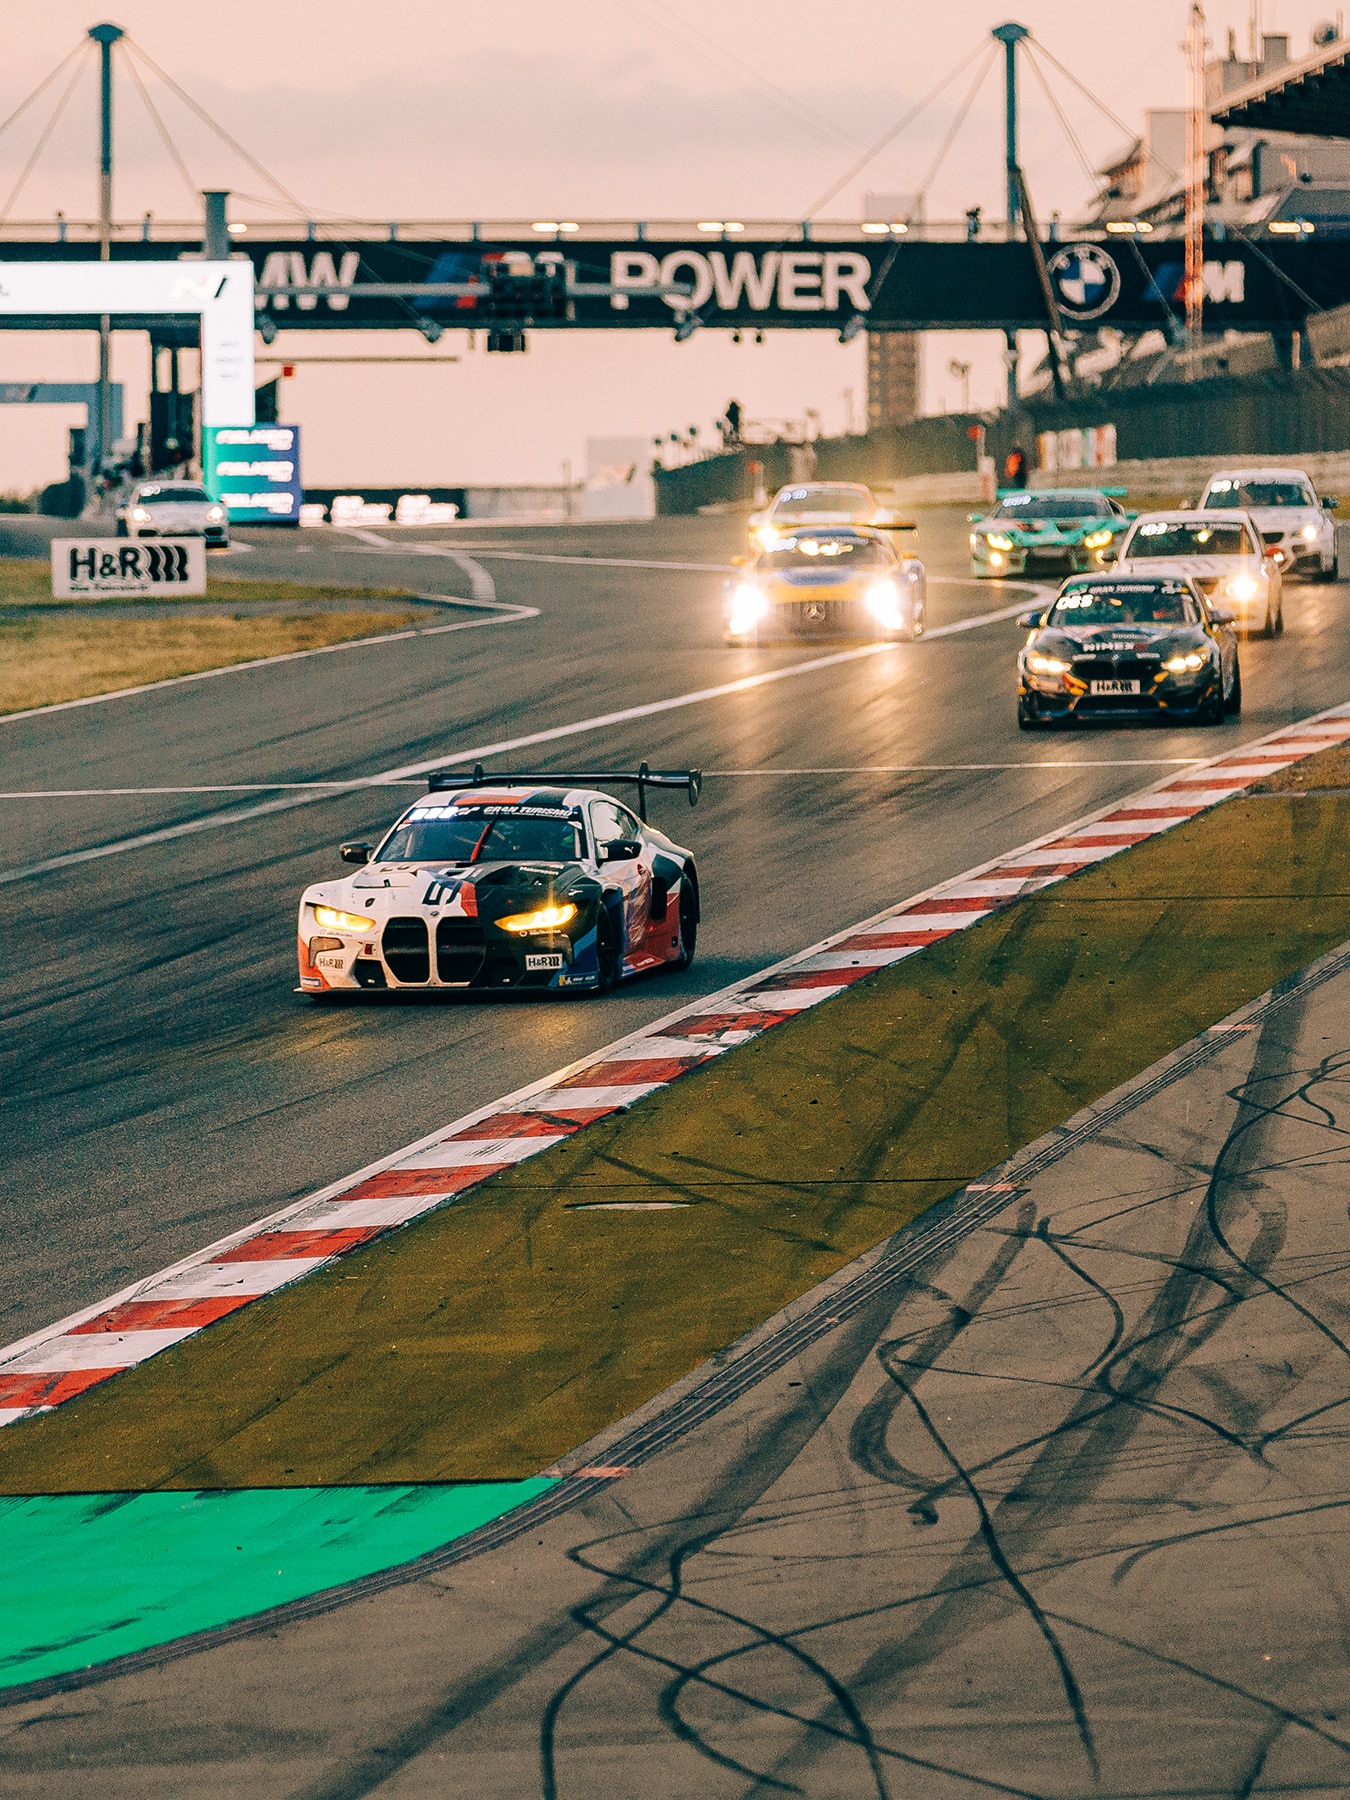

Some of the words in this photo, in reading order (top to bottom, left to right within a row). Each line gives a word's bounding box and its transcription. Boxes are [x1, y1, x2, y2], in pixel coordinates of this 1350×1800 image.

[225, 251, 361, 311] MW
[610, 250, 872, 311] POWER
[69, 546, 142, 581] H&R
[483, 806, 519, 814] GRAN
[519, 806, 573, 817] TURISMO
[528, 957, 548, 967] H&R
